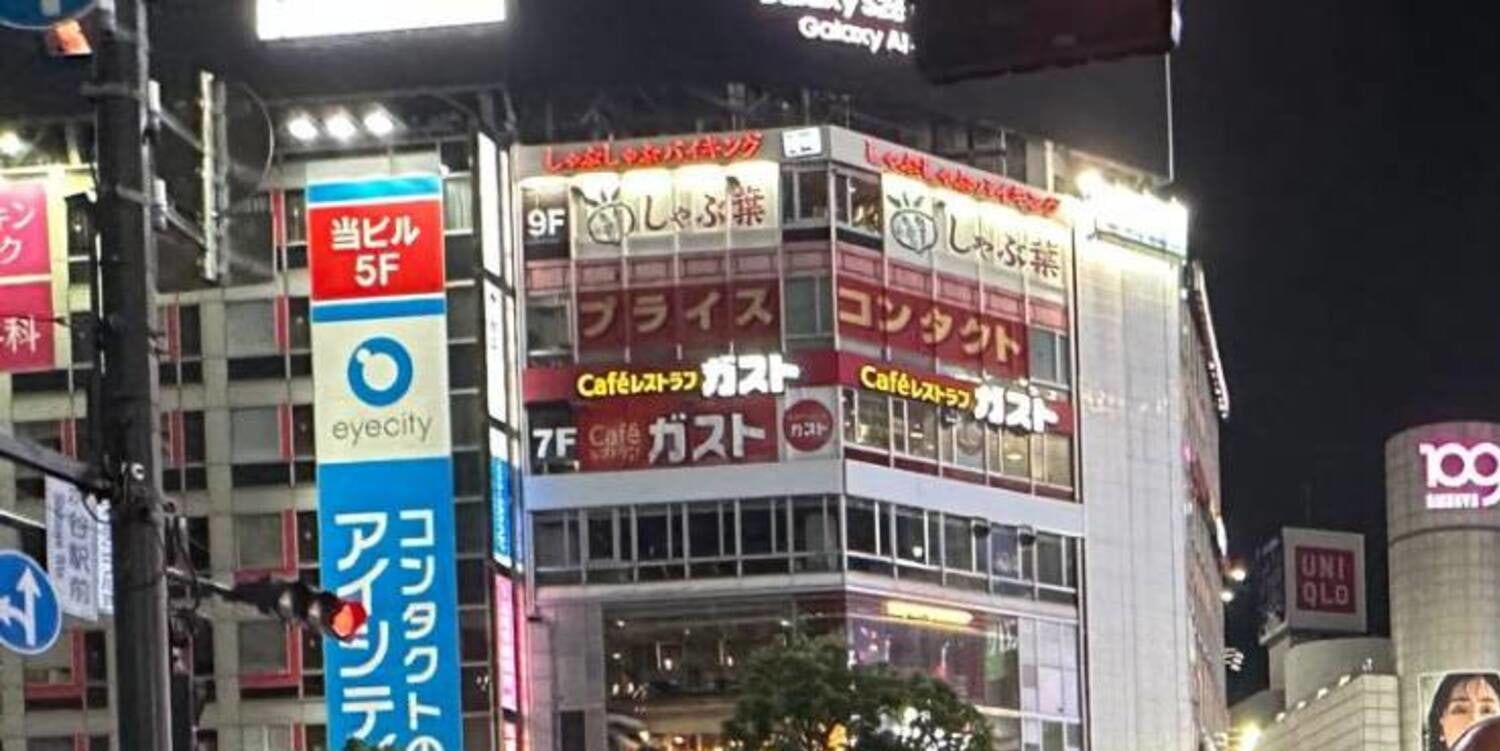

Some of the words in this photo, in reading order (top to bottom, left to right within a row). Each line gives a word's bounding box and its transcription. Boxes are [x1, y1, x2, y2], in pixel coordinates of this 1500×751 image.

[798, 15, 884, 54] Galaxy
[887, 29, 910, 55] AI
[527, 208, 566, 237] 9F
[644, 184, 766, 231] しゃぶ葉
[331, 215, 421, 250] 当ビル
[949, 213, 1060, 279] しゃぶ葉
[355, 253, 400, 287] 5F
[0, 314, 42, 353] 科
[838, 287, 1021, 362] コンタクト
[701, 353, 800, 398] ガスト
[974, 384, 1059, 433] ガスト
[332, 411, 433, 446] eyecity
[532, 427, 577, 459] 7F
[649, 412, 766, 465] ガスト
[1301, 551, 1345, 581] UNI
[1302, 581, 1350, 609] QLO
